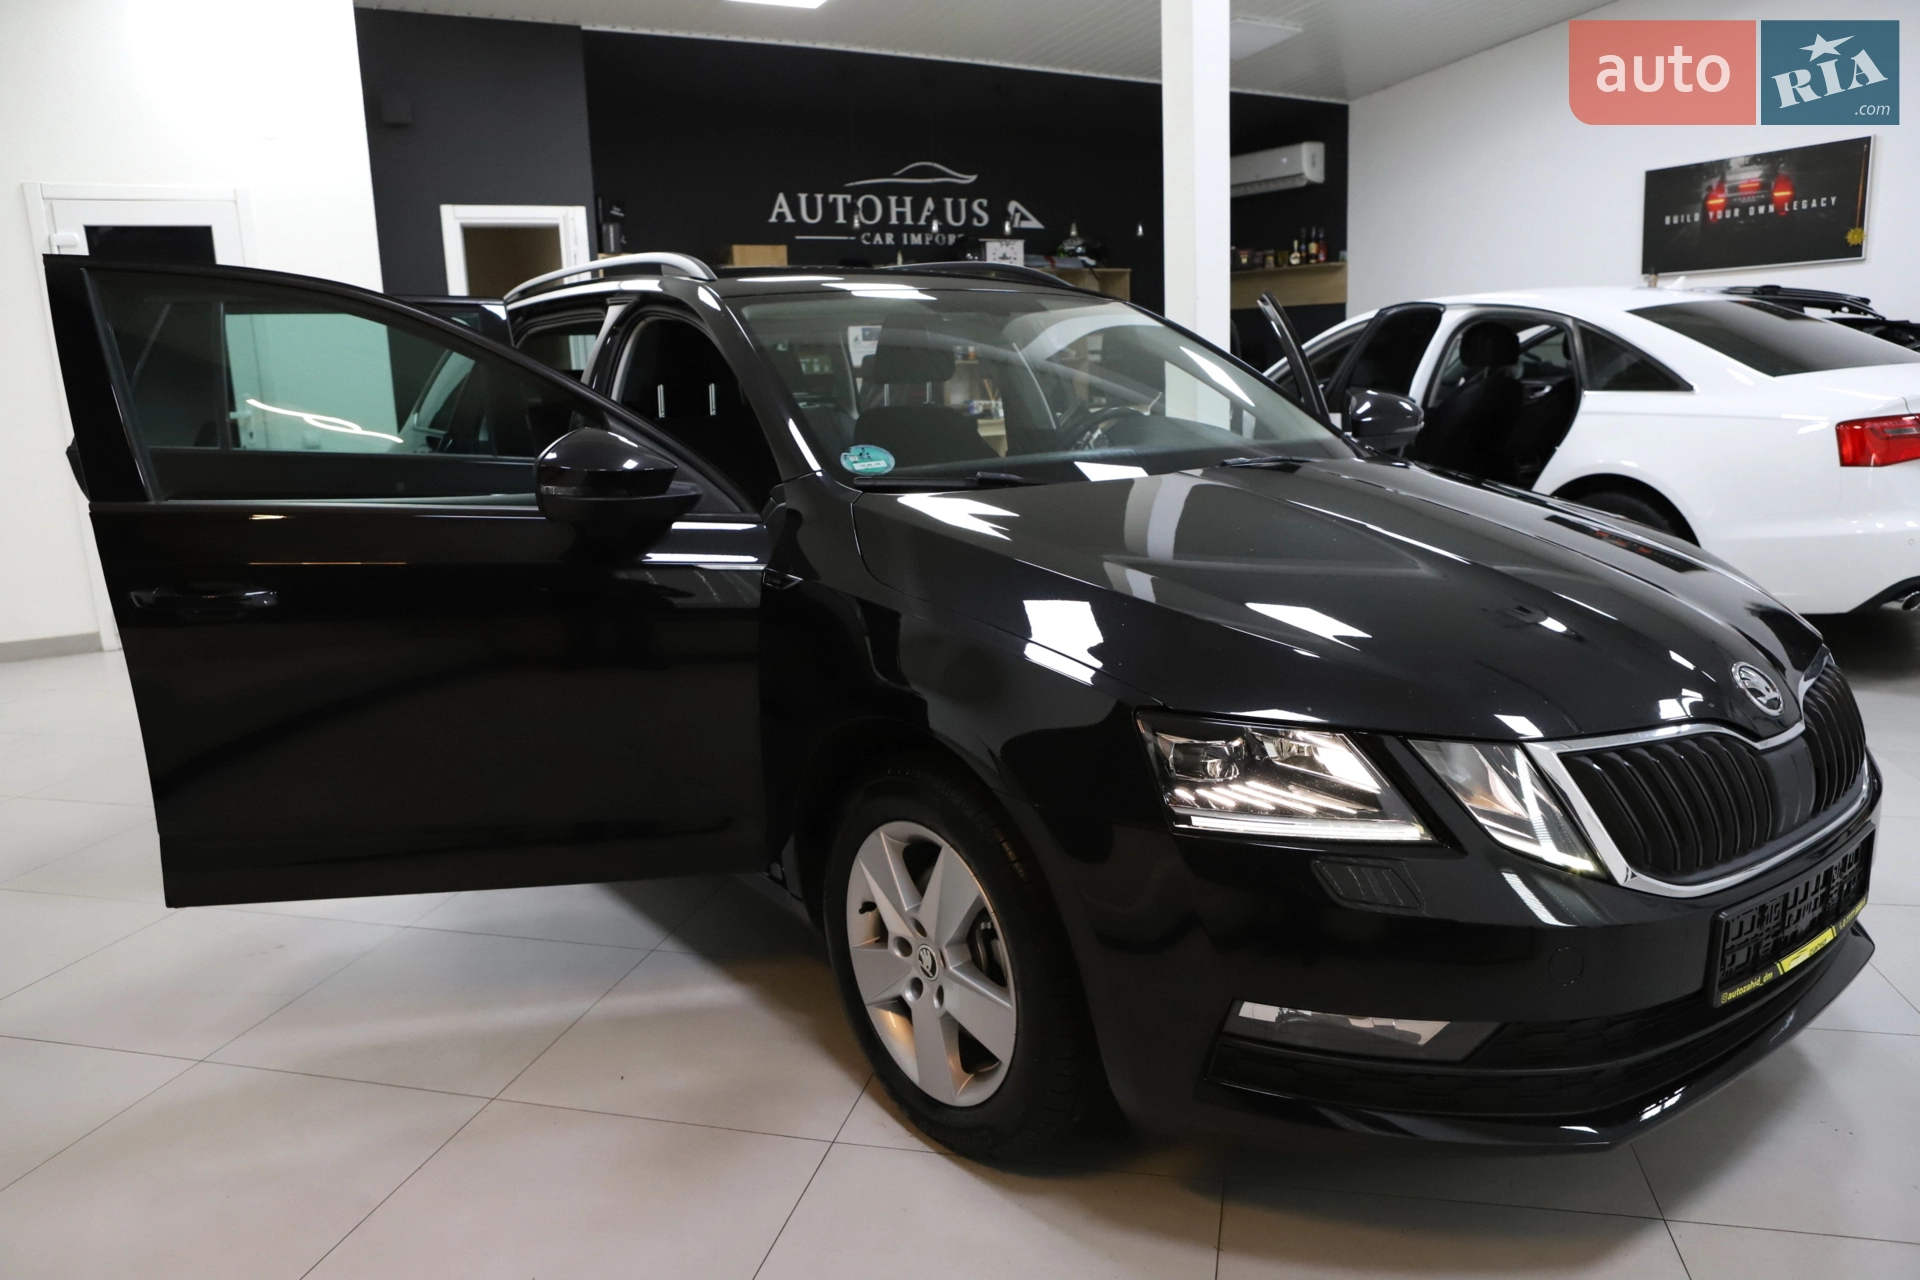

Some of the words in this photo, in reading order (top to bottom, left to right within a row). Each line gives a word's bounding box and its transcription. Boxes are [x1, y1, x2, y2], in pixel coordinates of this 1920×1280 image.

[768, 192, 989, 227] AUTOHAUS
[1665, 212, 1700, 225] BUILD
[1708, 207, 1740, 220] YOUR
[1749, 204, 1775, 217] OWN
[1784, 196, 1837, 212] LEGACY
[860, 232, 895, 246] CAR
[902, 232, 965, 246] IMPOR
